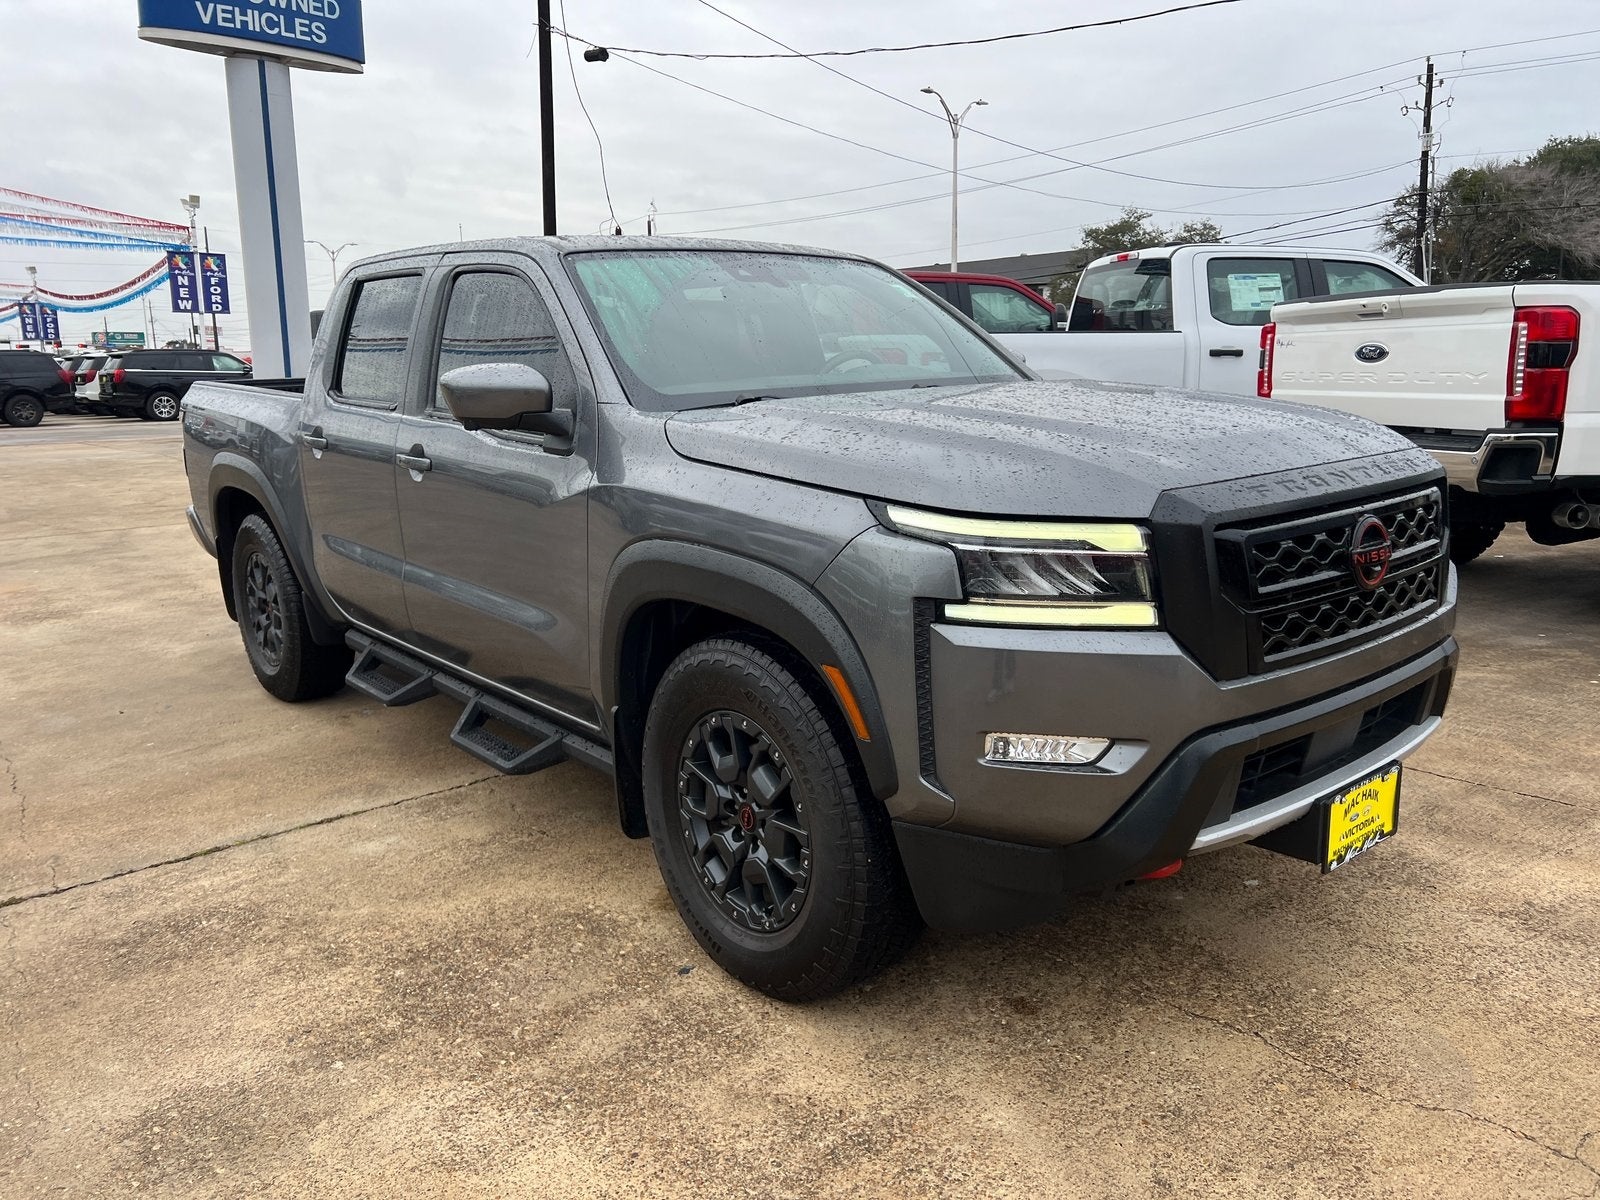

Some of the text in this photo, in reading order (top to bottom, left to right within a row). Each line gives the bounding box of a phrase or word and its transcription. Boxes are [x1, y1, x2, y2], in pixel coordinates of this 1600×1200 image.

[249, 0, 340, 20] NED
[195, 1, 327, 44] VEHICLES
[177, 275, 192, 310] NEW
[210, 277, 223, 312] FORD
[24, 317, 36, 339] NEW
[46, 317, 56, 340] FORD
[1360, 346, 1380, 359] Ford
[1281, 371, 1489, 385] SUPER DUTY
[1246, 456, 1421, 498] FRONTIER
[1343, 792, 1360, 820] MAC
[1361, 788, 1380, 803] HAIK
[1344, 816, 1376, 840] VICTORIA
